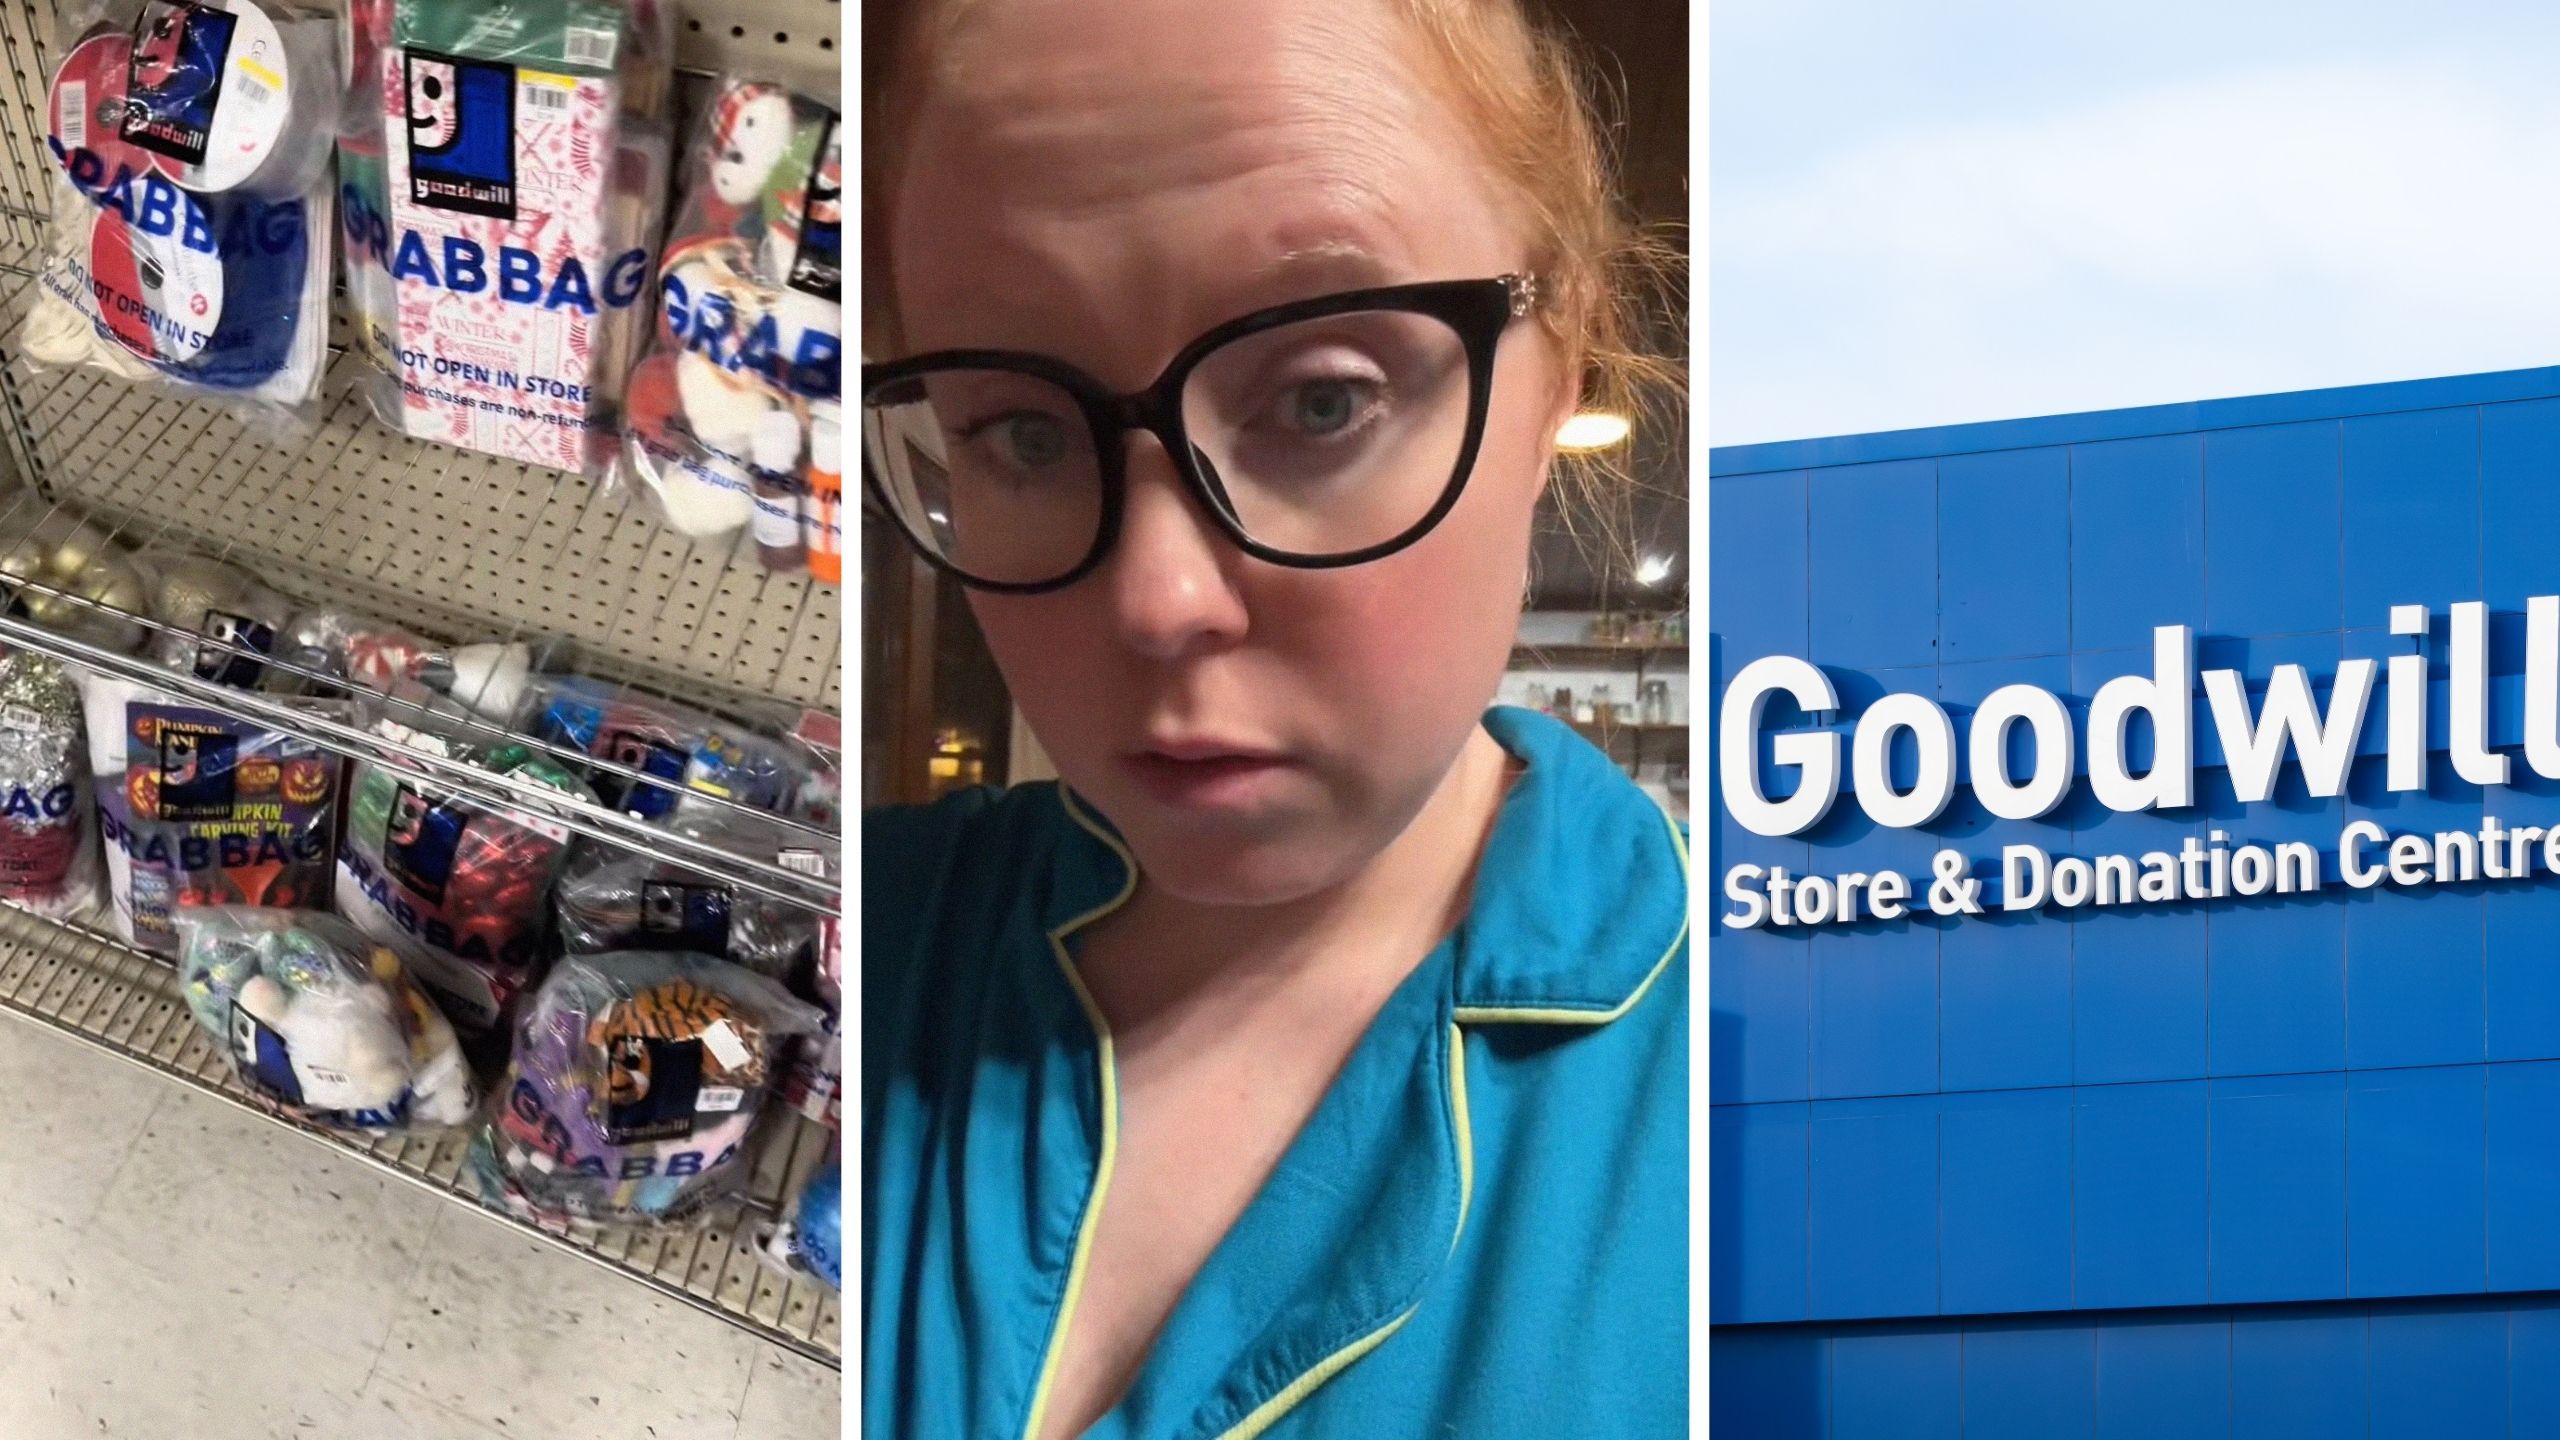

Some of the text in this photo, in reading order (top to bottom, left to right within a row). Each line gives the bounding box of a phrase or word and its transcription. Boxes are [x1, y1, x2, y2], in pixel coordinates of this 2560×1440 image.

[415, 177, 510, 205] goodwill
[116, 294, 162, 333] OPEN
[165, 319, 186, 344] IN
[403, 381, 477, 411] purchases
[479, 402, 505, 415] are
[433, 357, 489, 383] OPEN
[496, 369, 519, 389] IN
[525, 375, 593, 402] STORE
[1720, 595, 2560, 837] Goodwill
[0, 783, 75, 818] AG
[1721, 863, 1912, 930] Store
[1928, 848, 1984, 916] &
[2003, 829, 2319, 912] Donation
